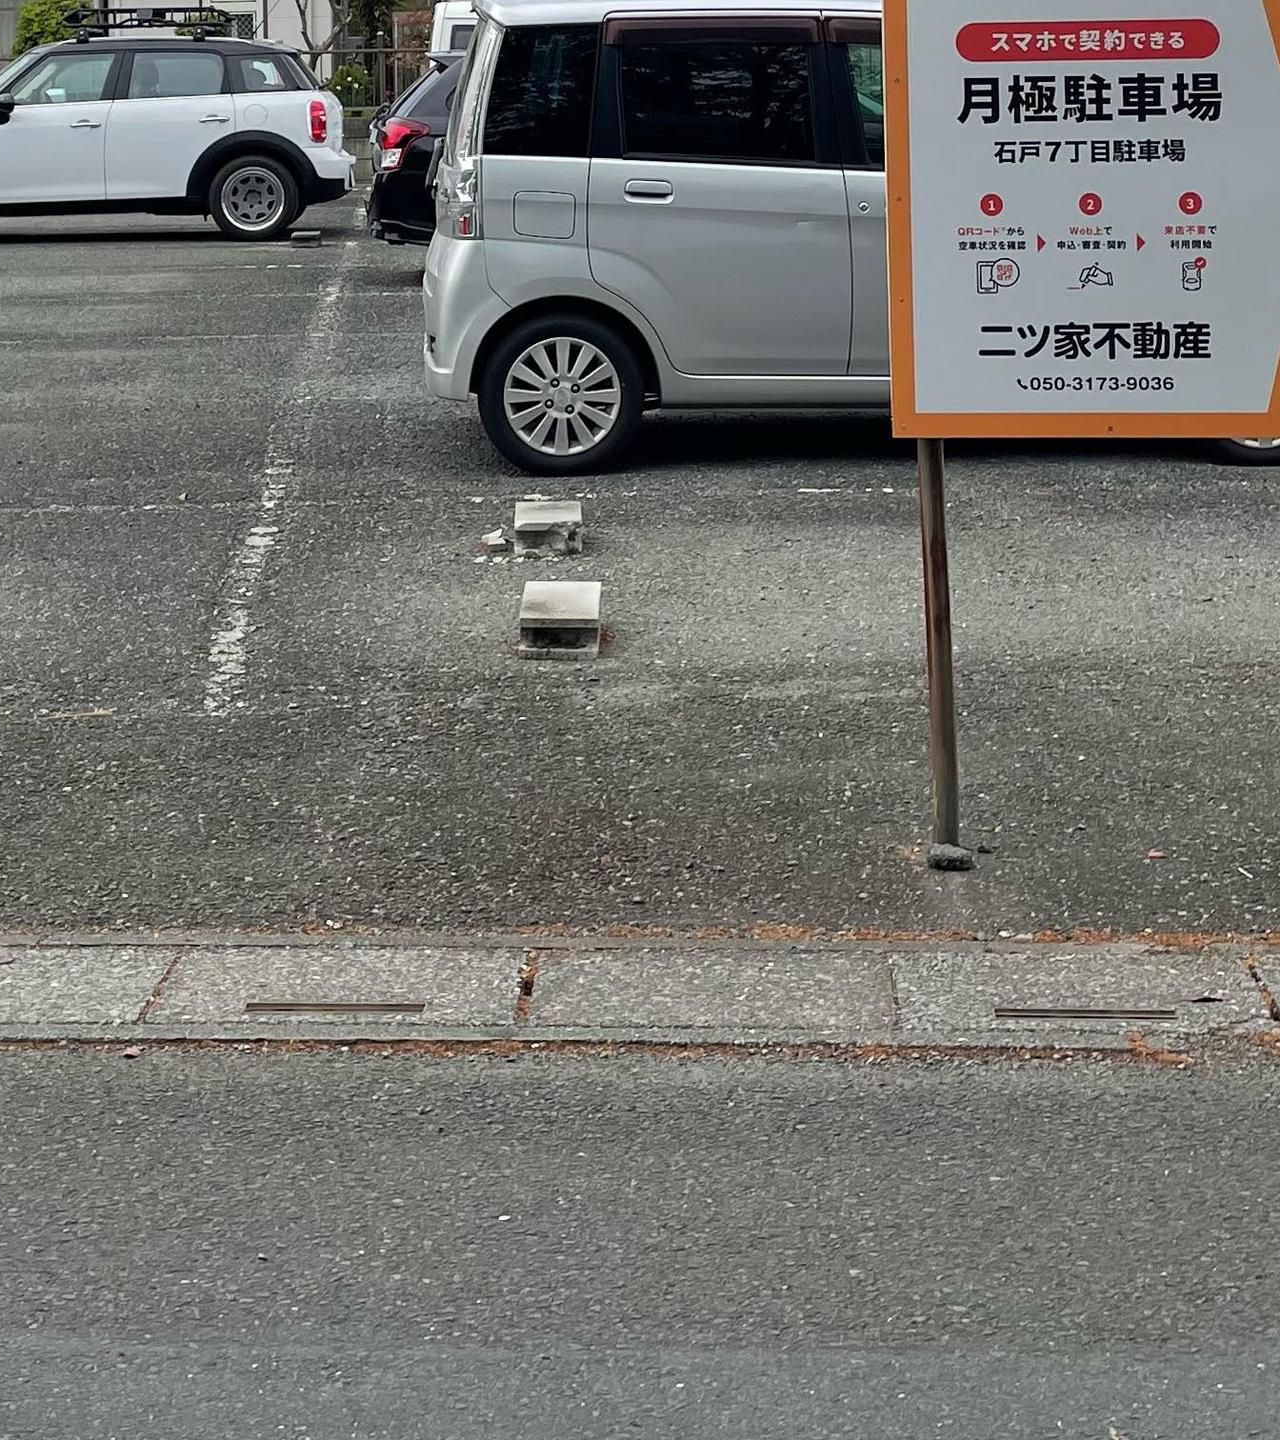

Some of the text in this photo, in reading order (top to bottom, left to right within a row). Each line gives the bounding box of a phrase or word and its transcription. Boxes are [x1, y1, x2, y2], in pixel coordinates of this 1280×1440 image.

[990, 29, 1185, 52] スマホで契約できる
[957, 72, 1223, 125] 月極駐車場
[993, 138, 1186, 163] 石戸7丁目駐車場
[978, 321, 1212, 360] 二ツ家不動産
[1029, 377, 1175, 391] 050-3173-9036
